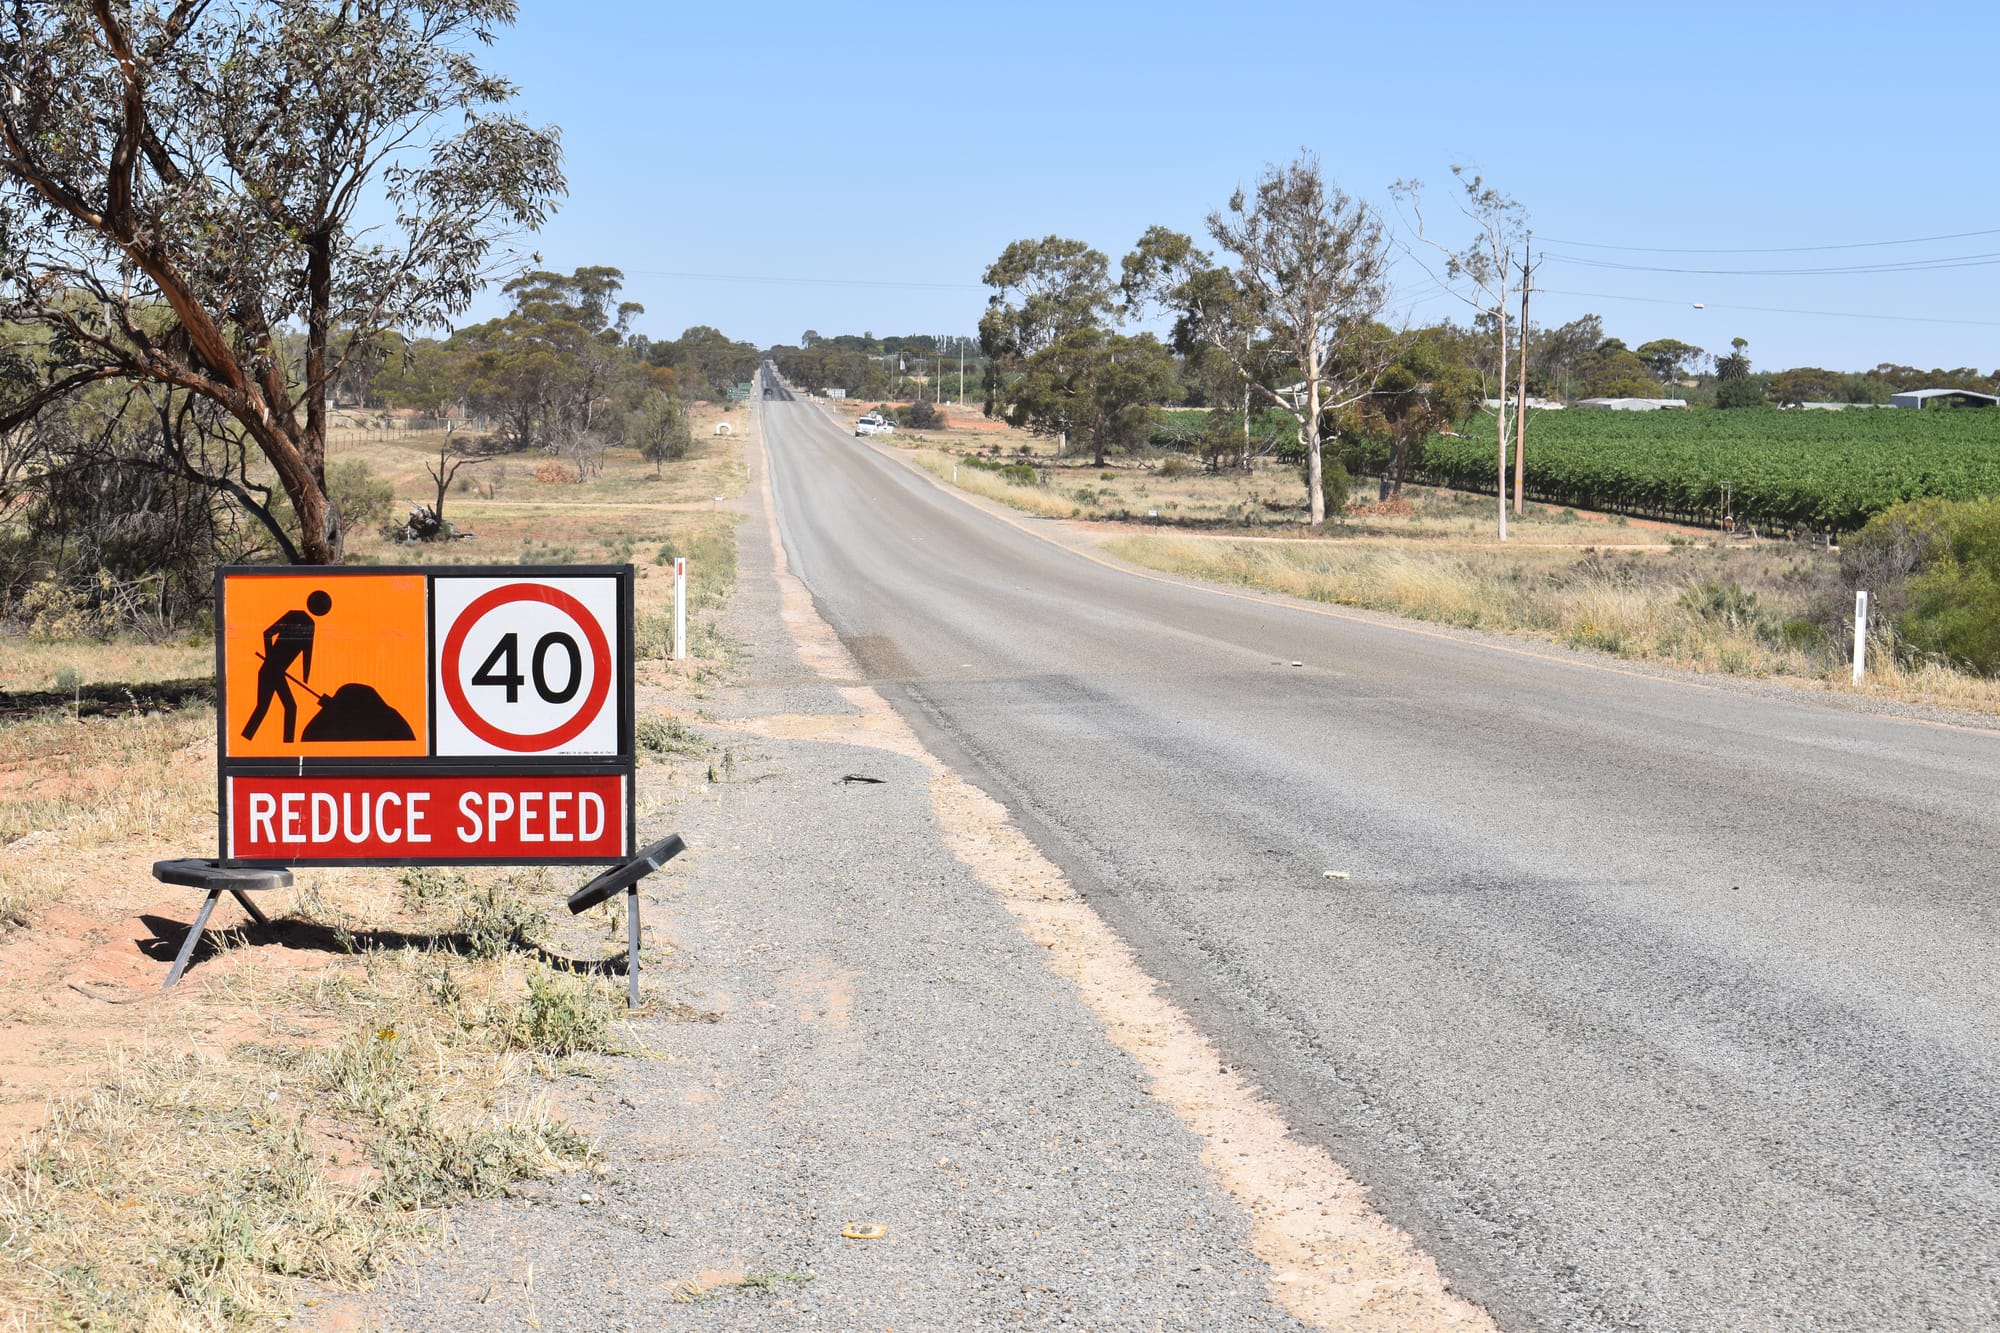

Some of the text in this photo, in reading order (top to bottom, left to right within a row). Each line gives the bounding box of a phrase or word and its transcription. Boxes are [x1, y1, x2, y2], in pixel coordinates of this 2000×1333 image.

[471, 631, 582, 704] 40
[249, 791, 605, 844] REDUCE SPEED
